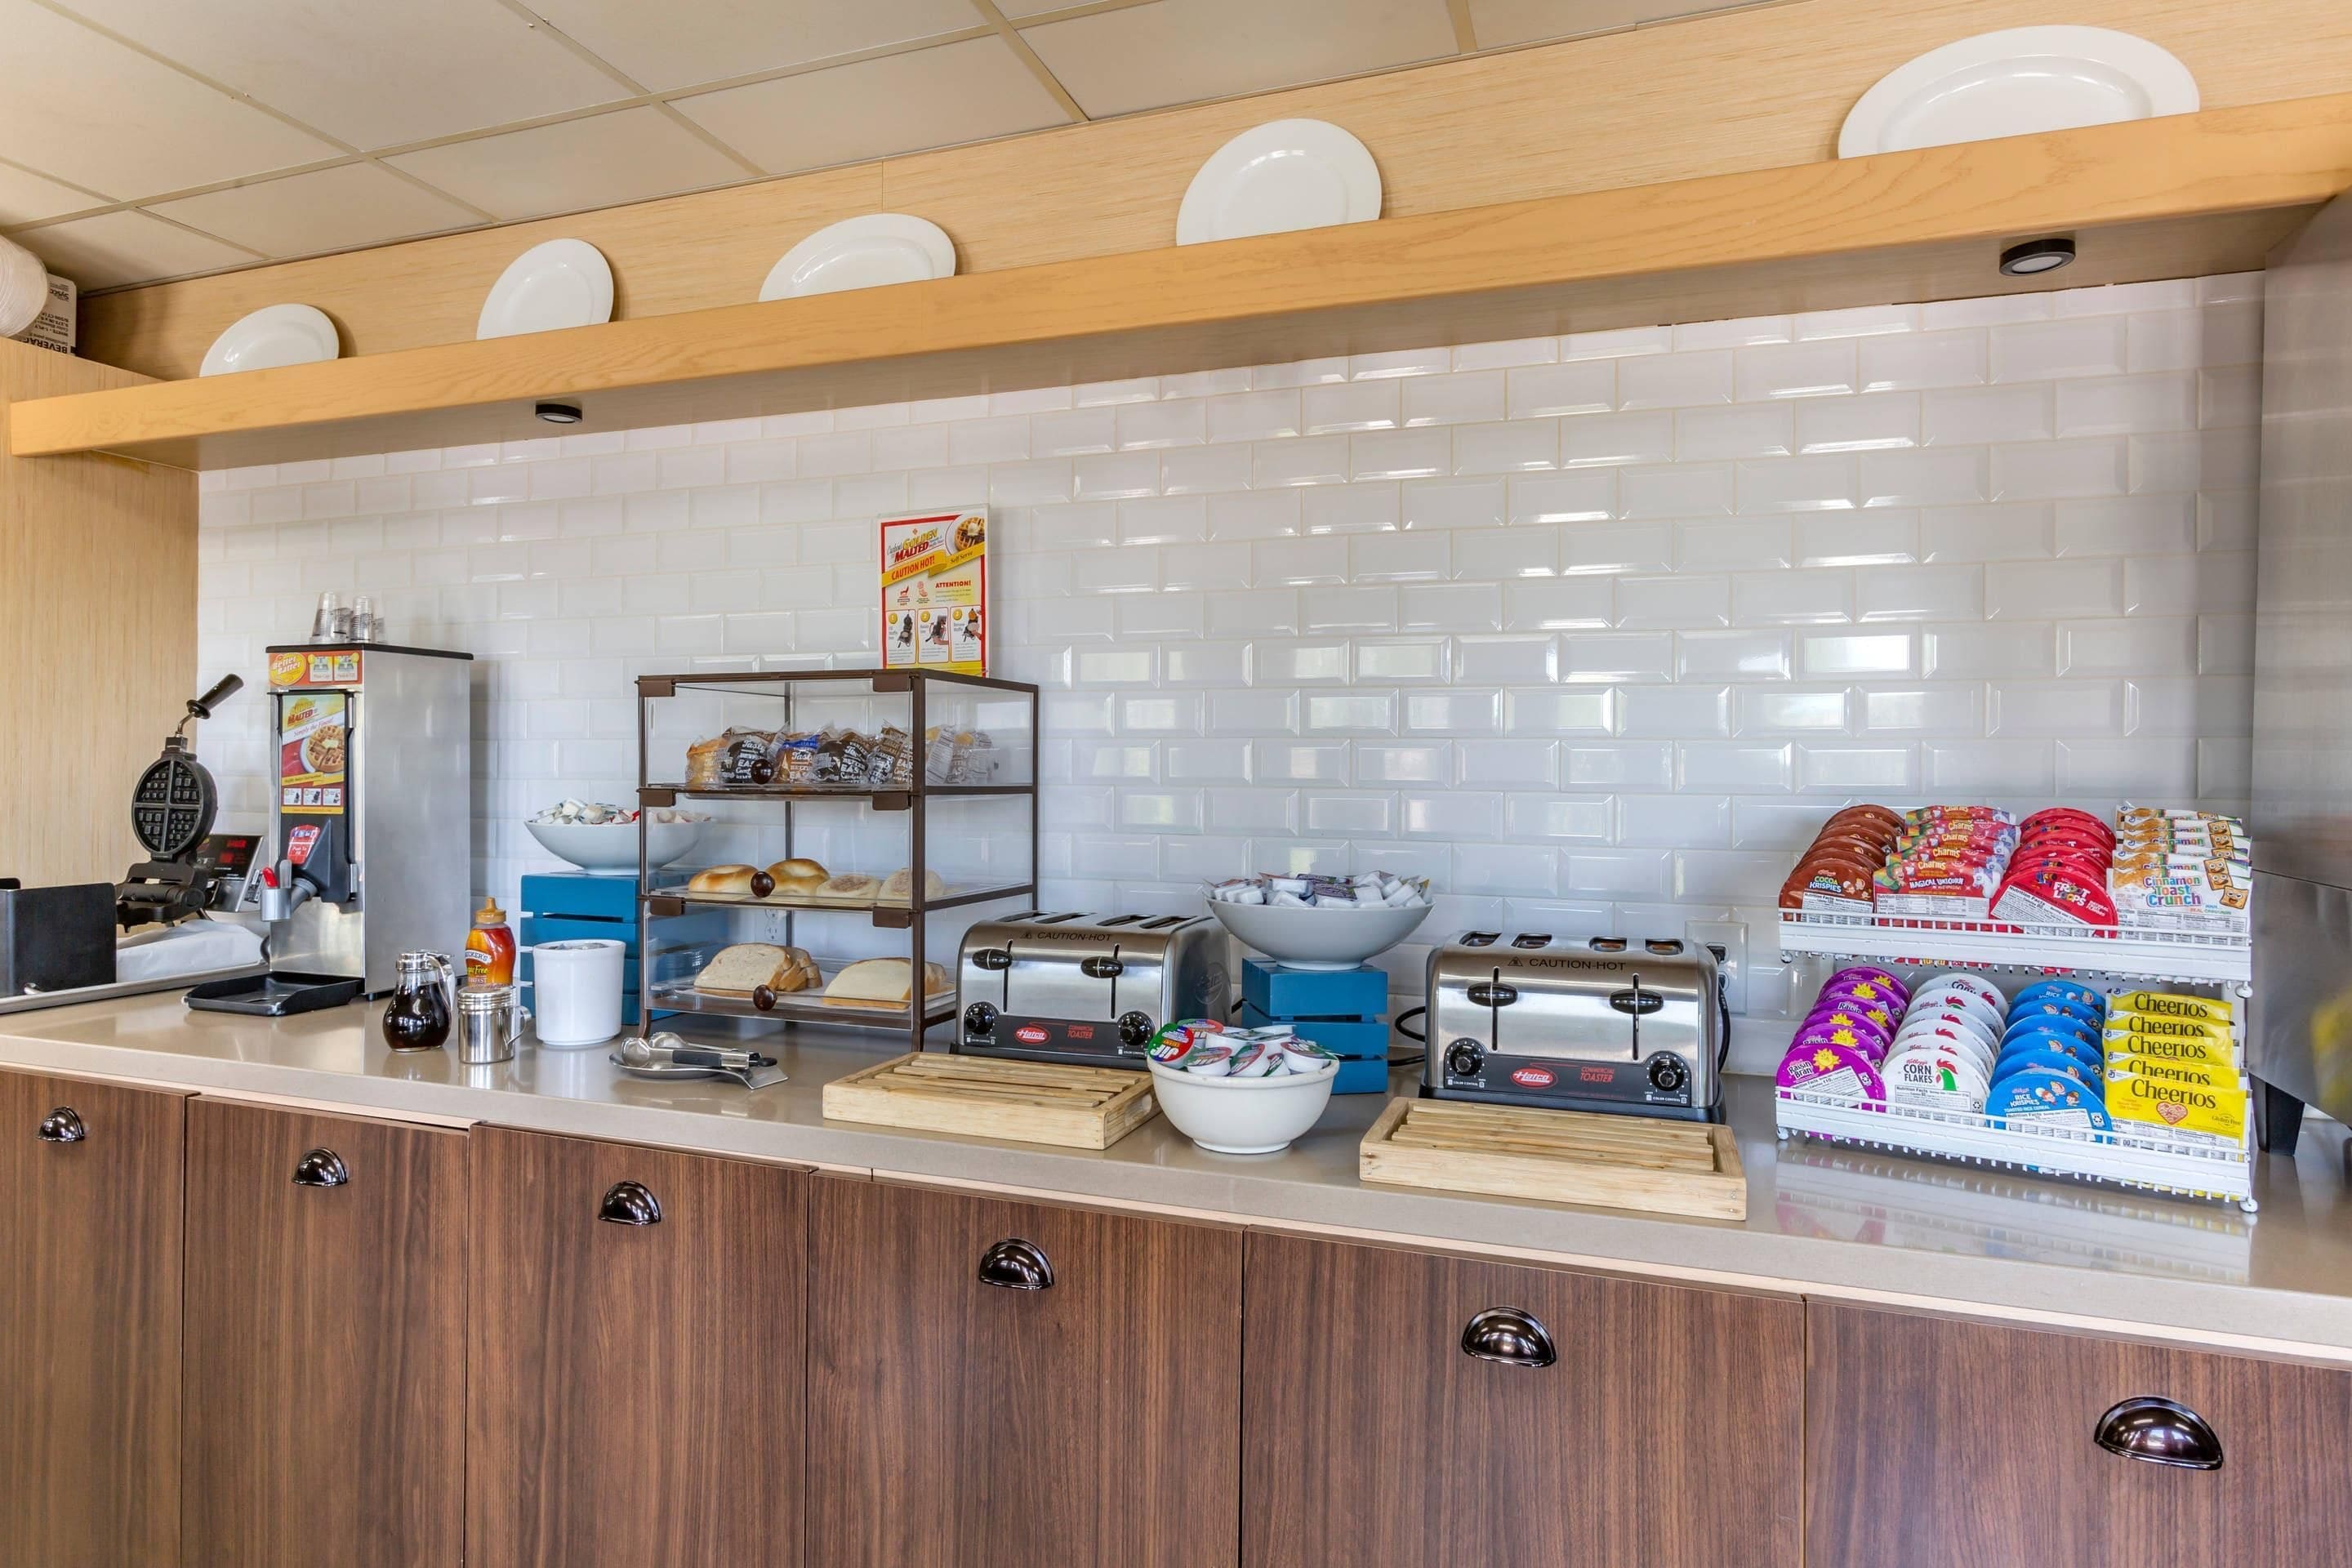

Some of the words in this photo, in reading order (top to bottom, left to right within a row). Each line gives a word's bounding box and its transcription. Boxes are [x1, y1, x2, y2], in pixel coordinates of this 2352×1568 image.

[894, 541, 929, 563] MALTED
[951, 555, 960, 564] Self
[960, 551, 973, 559] Serve
[891, 562, 920, 581] CAUTION
[920, 555, 935, 569] HOT!
[935, 580, 972, 589] ATTENTION!
[273, 656, 297, 670] Better
[278, 661, 301, 675] Batter
[287, 709, 314, 725] MALTED
[1948, 822, 1975, 831] Charms
[1941, 834, 1969, 843] Charms
[1932, 848, 1961, 858] Charms
[1918, 861, 1947, 871] Charms
[1815, 875, 1838, 885] COCOA
[1909, 878, 1936, 889] MAGICAL
[1936, 877, 1964, 885] UNICORN
[2144, 875, 2201, 886] Cinnamon
[1810, 882, 1842, 893] KRISPIES
[2054, 881, 2091, 897] FROOT
[2155, 884, 2190, 895] Toast
[2009, 885, 2031, 899] Nutrition
[2030, 895, 2046, 906] Facts
[2053, 891, 2087, 906] LOOPS
[2147, 893, 2202, 906] Crunch
[1037, 932, 1112, 942] CAUTION-HOT
[474, 964, 488, 975] Free
[1529, 958, 1626, 971] CAUTION-HOT
[1838, 1002, 1862, 1013] Raisin
[2134, 993, 2208, 1018] Cheerios
[2128, 1016, 2204, 1037] Cheerios
[1017, 1029, 1045, 1040] Hatco
[1067, 1030, 1094, 1040] TOASTER
[2127, 1035, 2207, 1059] Cheerios
[1581, 1066, 1615, 1074] COMMERCIAL
[1788, 1061, 1811, 1075] Raisin
[1793, 1067, 1813, 1079] Bran
[1904, 1064, 1931, 1075] CORN
[2128, 1059, 2211, 1086] Cheerios
[1512, 1071, 1551, 1083] Hatco
[1580, 1072, 1613, 1083] TOASTER
[1904, 1073, 1933, 1084] FLAKES
[2131, 1078, 2216, 1109] Cheerios
[2010, 1099, 2040, 1107] KRISPIES
[2212, 1116, 2230, 1124] Gluten
